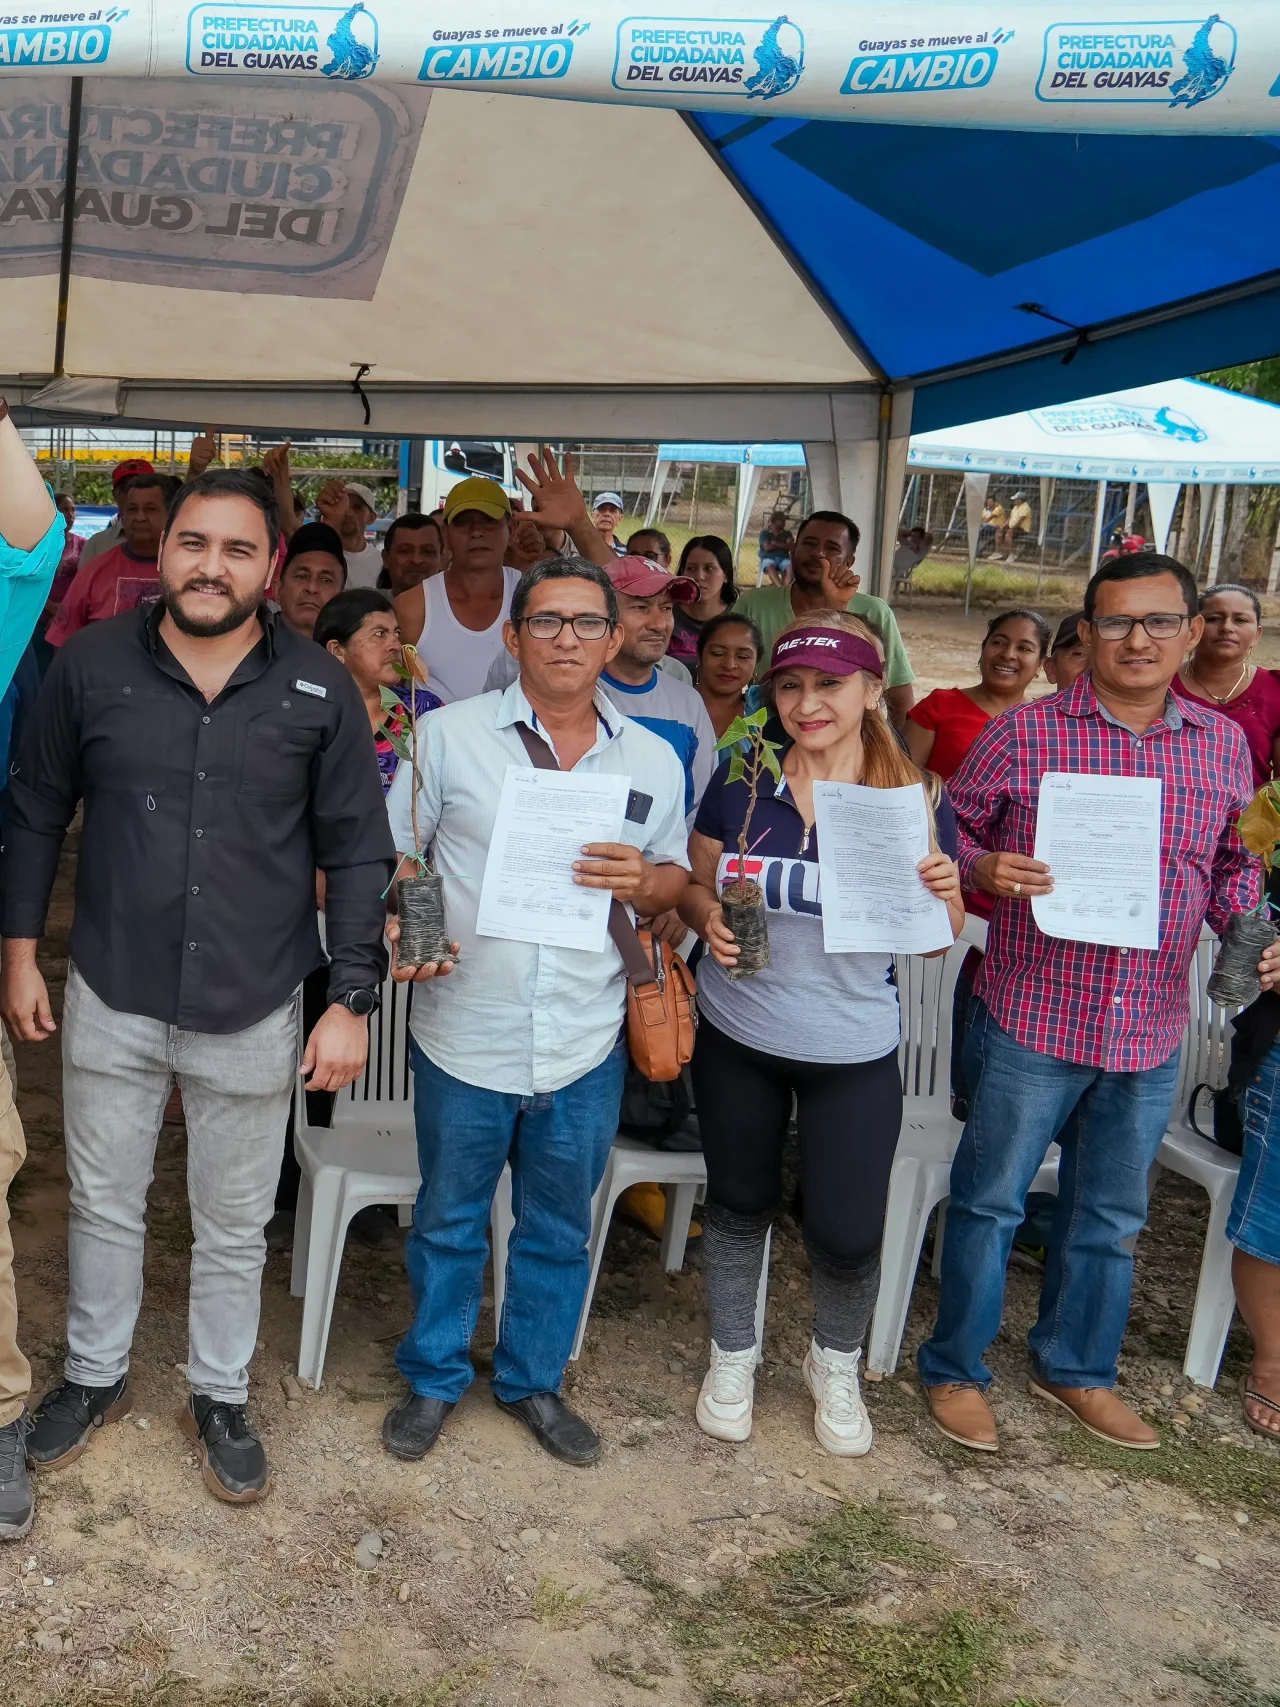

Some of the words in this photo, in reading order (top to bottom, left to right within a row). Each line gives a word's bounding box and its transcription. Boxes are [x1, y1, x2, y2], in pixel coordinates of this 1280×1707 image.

[21, 14, 37, 24] se
[39, 12, 85, 23] mueve
[85, 10, 102, 21] al
[202, 16, 319, 33] PREFECTURA
[201, 32, 319, 52] CIUDADANA
[431, 28, 481, 42] Guayas
[484, 29, 500, 39] se
[503, 26, 548, 38] mueve
[550, 23, 564, 35] al
[631, 29, 746, 46] PREFECTURA
[858, 38, 907, 52] Guayas
[909, 38, 925, 48] se
[927, 34, 973, 47] mueve
[975, 32, 988, 44] al
[1058, 34, 1176, 50] PREFECTURA
[200, 51, 238, 68] DEL
[241, 53, 318, 70] GUAYAS
[425, 43, 567, 79] CAMBIO
[630, 45, 745, 65] CIUDADANA
[1056, 51, 1174, 69] CIUDADANA
[625, 65, 664, 82] DEL
[667, 66, 743, 84] GUAYAS
[849, 52, 990, 90] CAMBIO
[1050, 71, 1089, 89] DEL
[1093, 71, 1171, 89] GUAYAS
[1053, 425, 1088, 433] DEL
[776, 636, 841, 656] TAE-TEK
